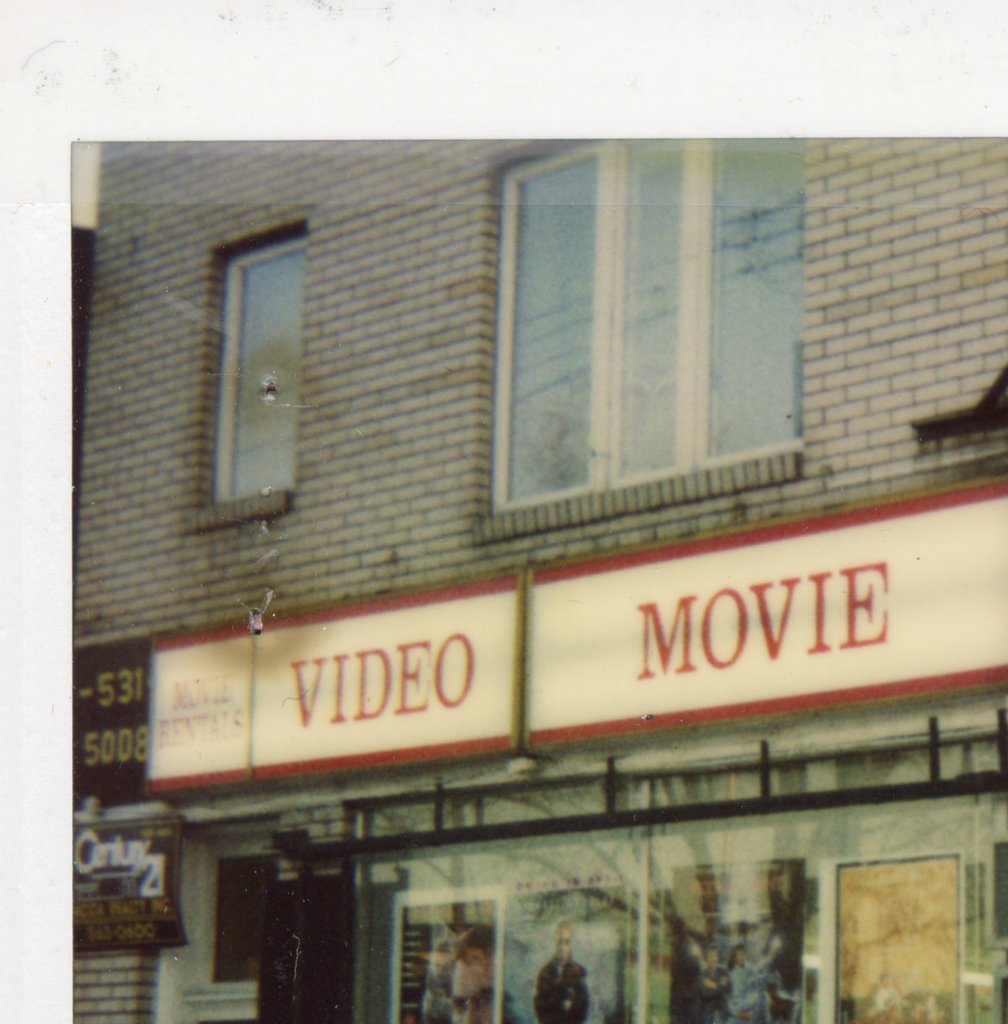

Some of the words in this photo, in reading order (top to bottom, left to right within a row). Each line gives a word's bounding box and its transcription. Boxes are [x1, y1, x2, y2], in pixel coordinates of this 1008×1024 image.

[290, 633, 475, 727] VIDEO
[637, 562, 888, 680] MOVIE
[84, 724, 149, 767] 5008
